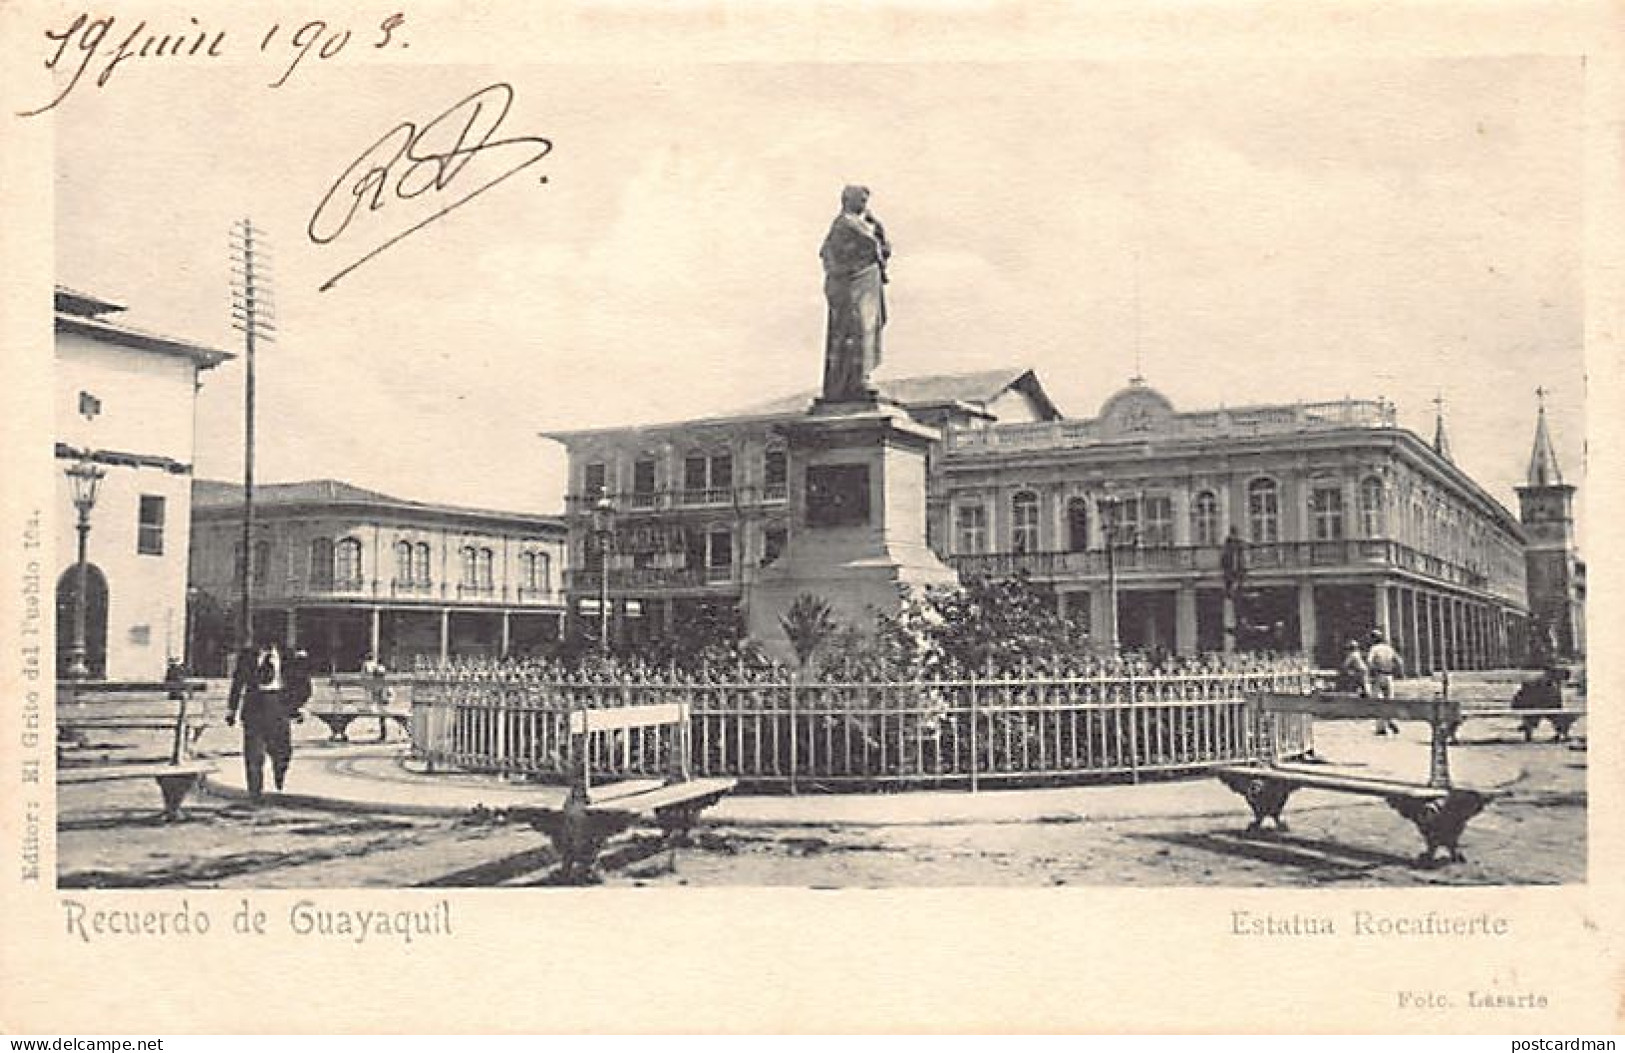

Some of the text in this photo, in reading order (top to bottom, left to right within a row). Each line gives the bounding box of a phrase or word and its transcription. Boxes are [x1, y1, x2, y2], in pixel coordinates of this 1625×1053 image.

[21, 646, 40, 681] del
[21, 691, 39, 749] Grito
[62, 900, 454, 943] Recuerdo de Guayaquil
[1230, 910, 1511, 936] Estatua Rocafuerte
